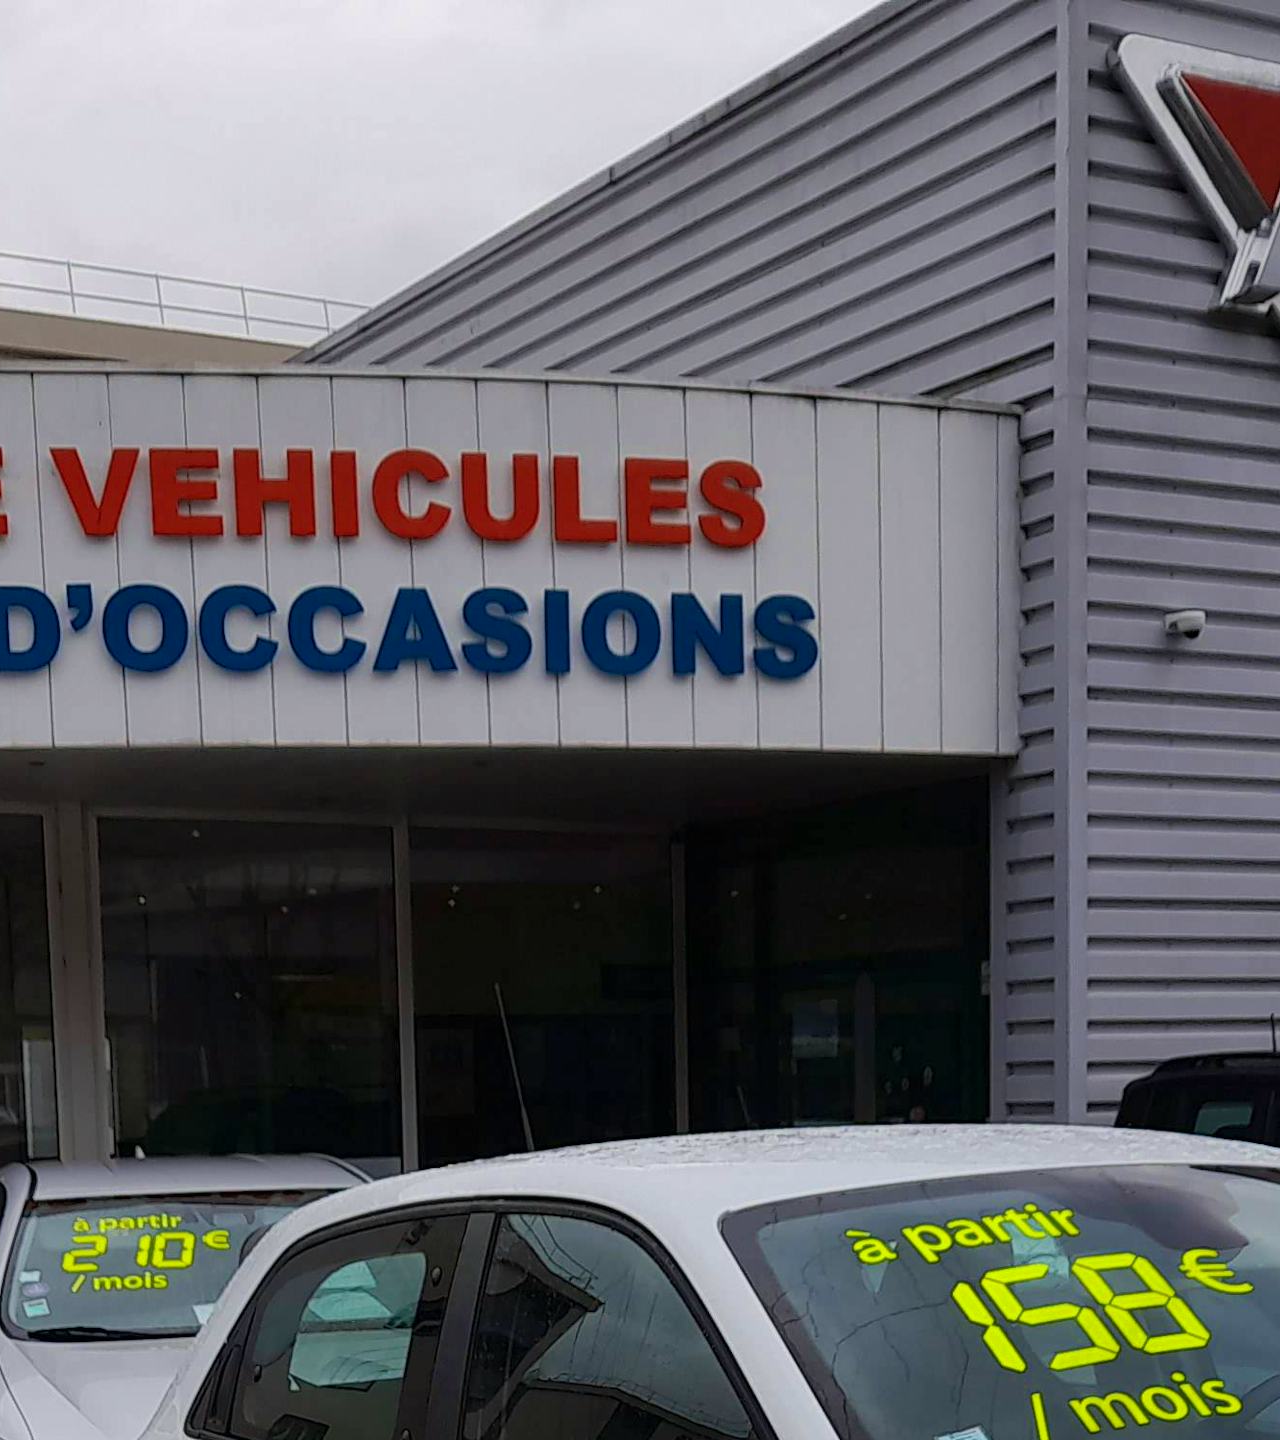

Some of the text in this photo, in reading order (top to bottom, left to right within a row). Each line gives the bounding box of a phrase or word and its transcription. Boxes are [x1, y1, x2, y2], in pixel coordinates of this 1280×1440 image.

[49, 446, 767, 549] VEHICULES
[73, 1212, 183, 1233] à partir
[844, 1202, 1082, 1266] à partir
[92, 1271, 169, 1292] mois
[1068, 1372, 1244, 1434] mois
